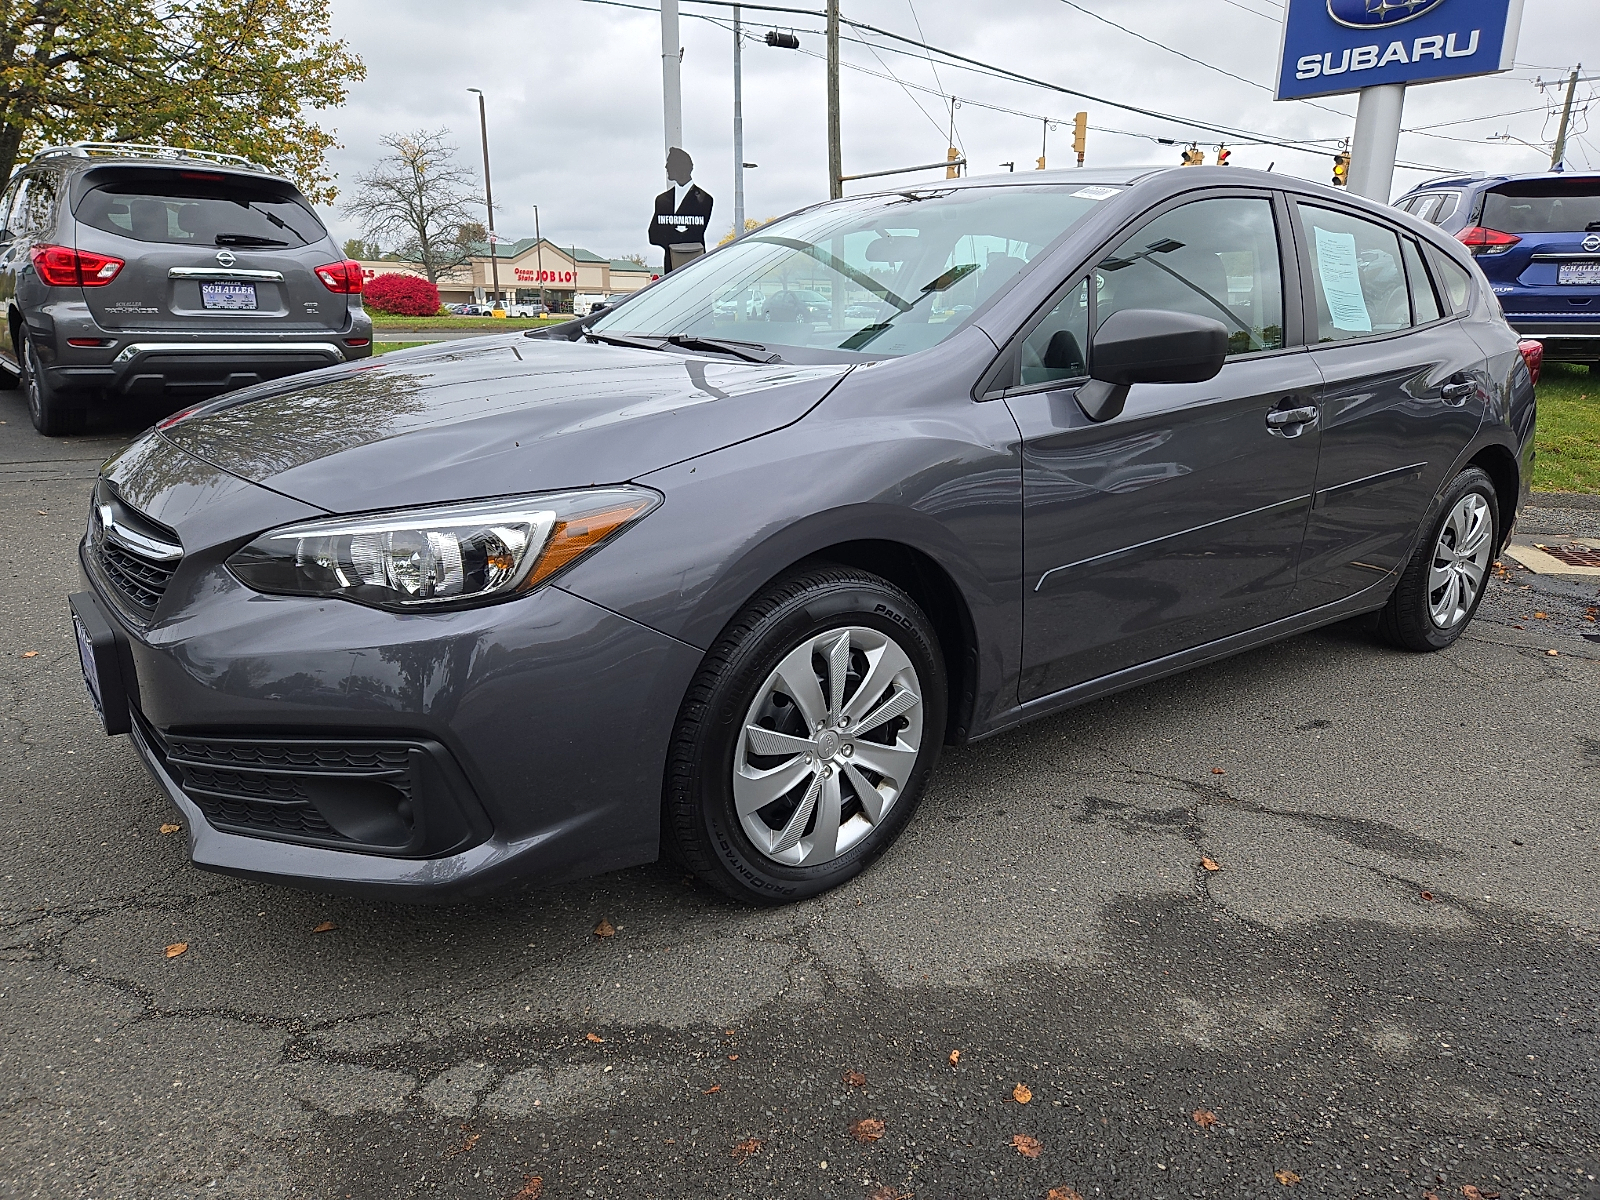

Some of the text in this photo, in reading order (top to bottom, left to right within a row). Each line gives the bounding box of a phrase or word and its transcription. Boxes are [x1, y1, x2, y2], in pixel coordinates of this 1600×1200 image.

[1295, 29, 1480, 80] SUBARU
[657, 214, 705, 225] INFORMATION
[514, 267, 534, 275] Ocean
[517, 274, 534, 282] State
[535, 270, 578, 283] JOB LOT
[202, 285, 255, 294] SCHALLER
